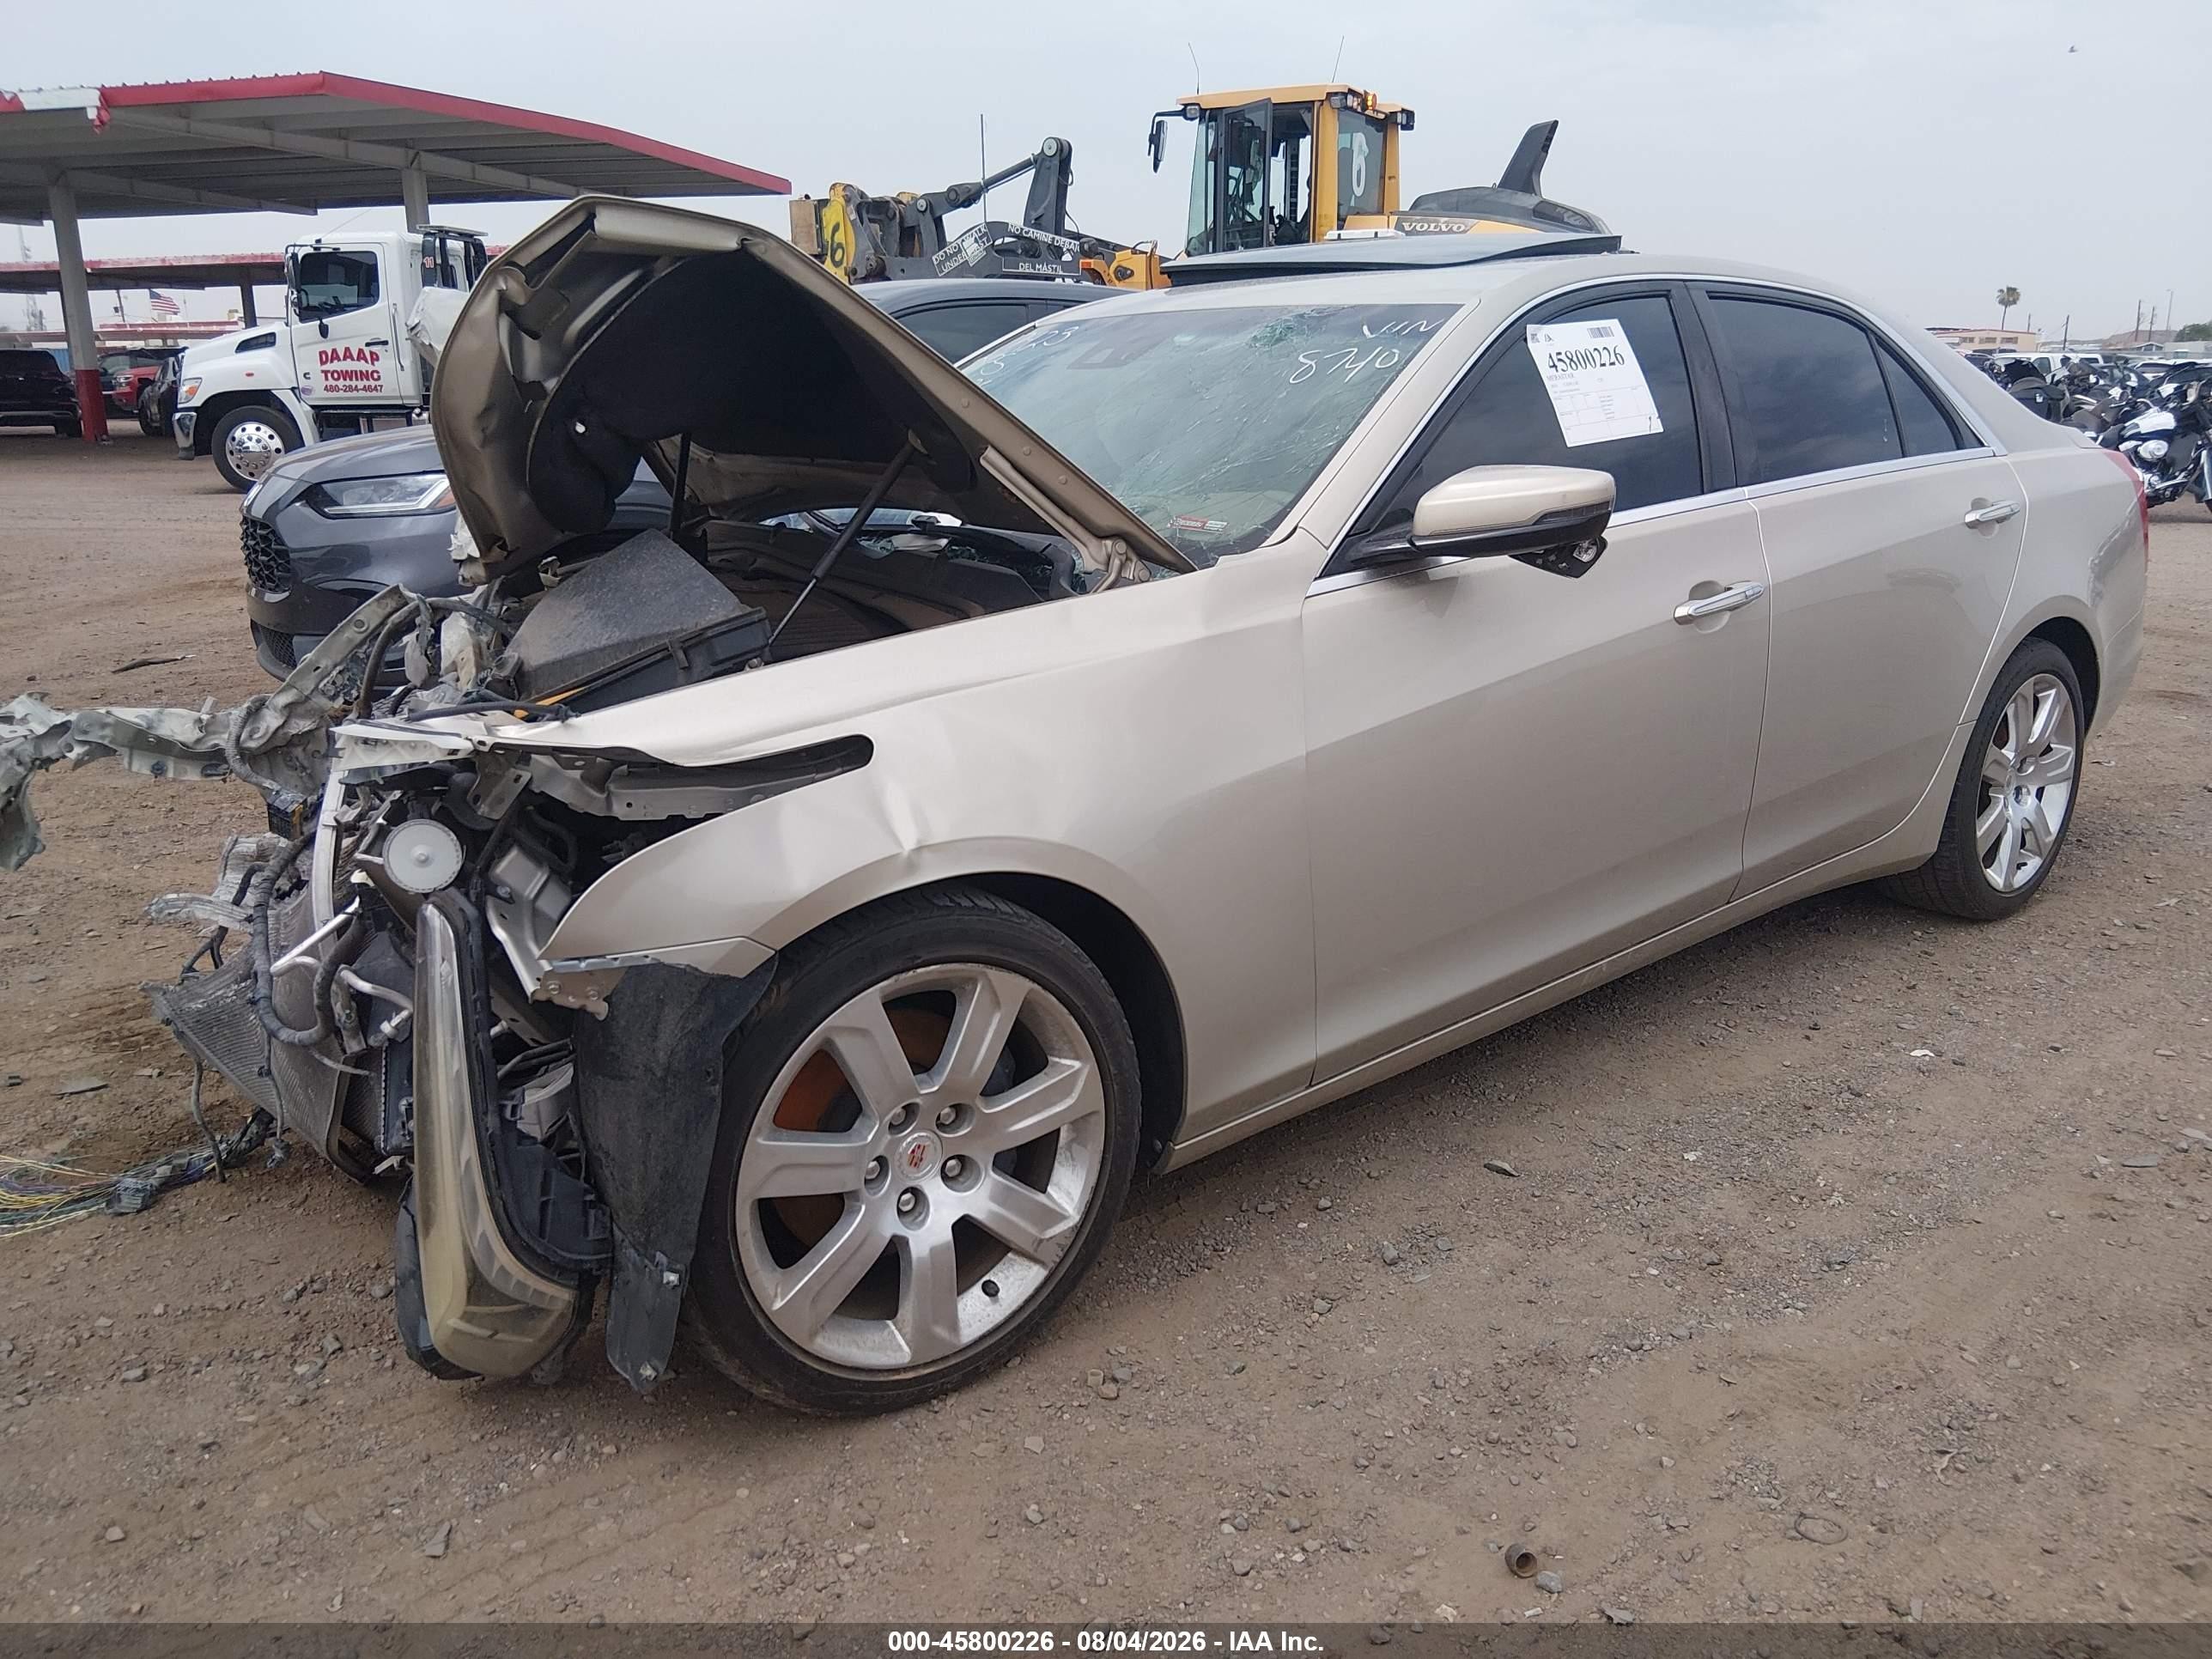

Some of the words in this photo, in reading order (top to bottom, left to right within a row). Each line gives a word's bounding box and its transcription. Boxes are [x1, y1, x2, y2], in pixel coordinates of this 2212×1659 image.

[1352, 132, 1369, 197] 6
[1008, 223, 1021, 234] NO
[1023, 228, 1053, 244] CAMINE
[1401, 222, 1466, 233] VOLVO
[830, 222, 845, 268] 6
[933, 252, 945, 264] DO
[946, 239, 963, 257] NOT
[963, 224, 988, 242] WALK
[423, 256, 434, 268] 11
[1019, 262, 1034, 271] DEL
[1036, 261, 1064, 273] MÁSTIL
[1362, 319, 1446, 339] VIN
[319, 346, 380, 366] DAAAP
[1289, 346, 1400, 384] 8740
[1547, 345, 1625, 373] 45800226
[320, 369, 381, 381] TOWING
